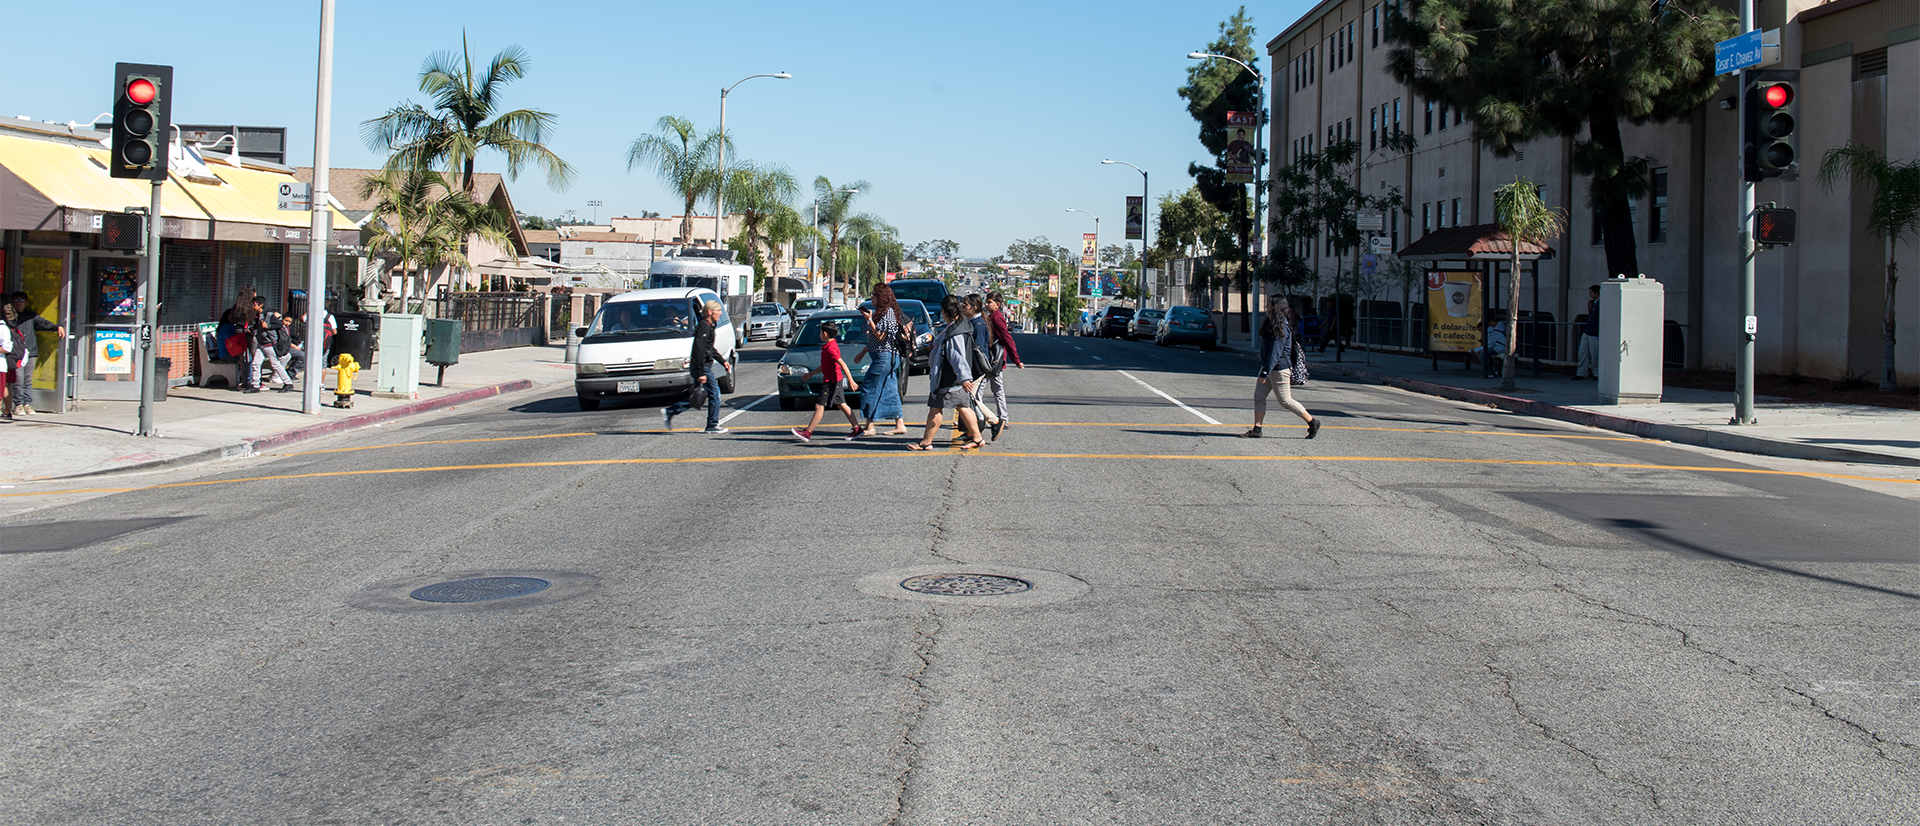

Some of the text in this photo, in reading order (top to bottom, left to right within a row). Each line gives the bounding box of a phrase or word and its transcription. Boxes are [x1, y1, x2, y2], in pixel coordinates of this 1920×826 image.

[1716, 58, 1730, 71] Cesar
[1736, 50, 1753, 65] Chavez
[1754, 46, 1762, 60] Av
[1229, 116, 1253, 124] EAST
[1441, 322, 1476, 331] dolarcito
